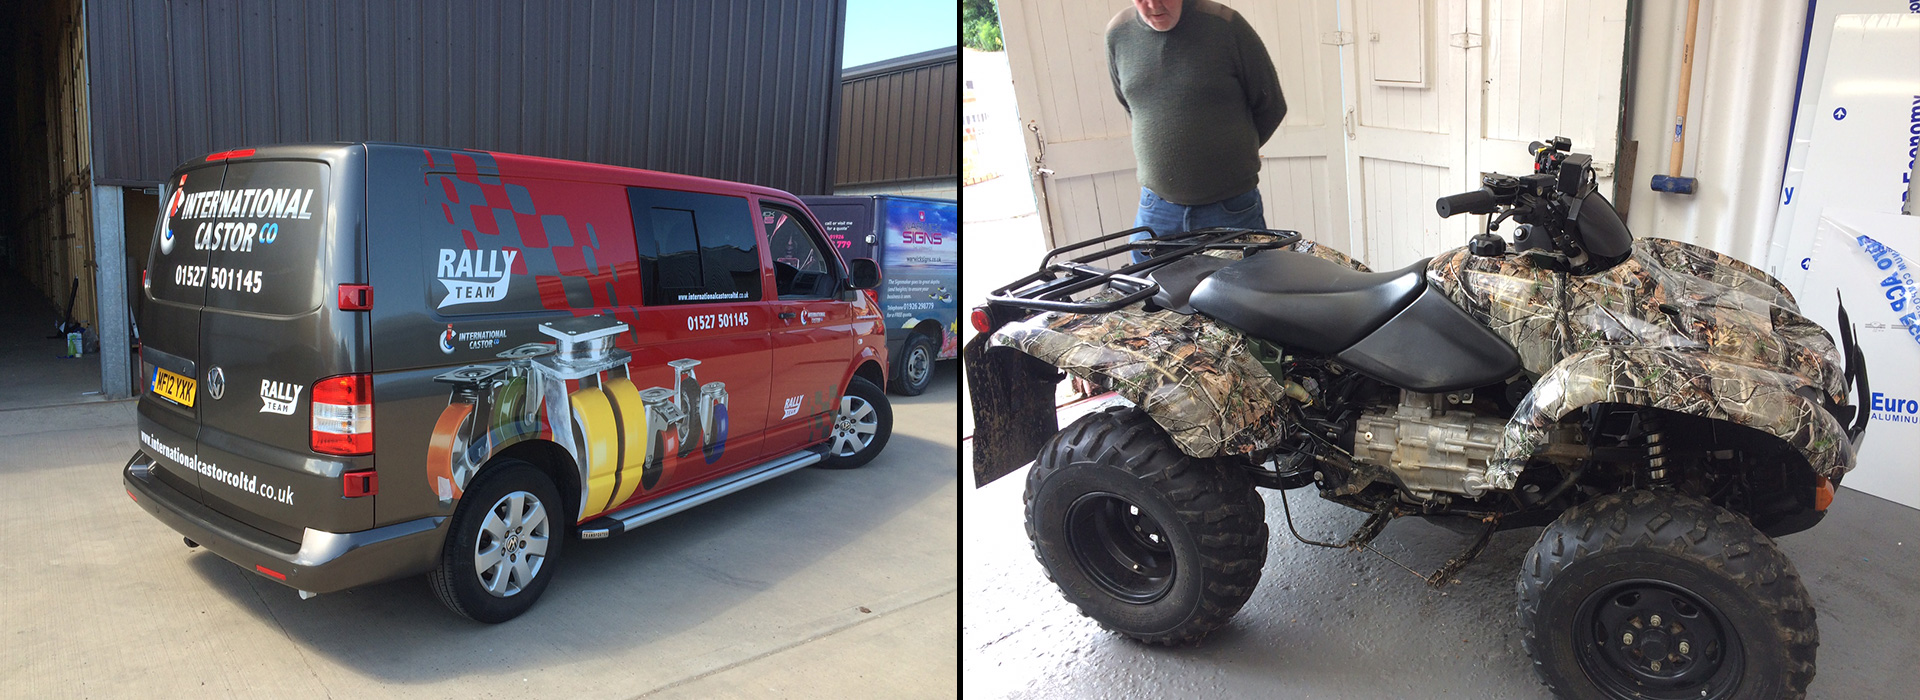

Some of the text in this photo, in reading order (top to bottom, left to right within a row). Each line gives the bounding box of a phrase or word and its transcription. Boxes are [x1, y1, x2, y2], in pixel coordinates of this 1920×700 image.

[181, 188, 314, 219] INTERNATIONAL
[194, 222, 278, 252] CASTOR CO
[837, 240, 852, 249] 779
[902, 231, 943, 245] SIGNS
[437, 249, 517, 278] RALLY
[175, 265, 263, 294] 01527 501145
[455, 286, 495, 299] TEAM
[687, 312, 749, 331] 01527 501145
[459, 330, 507, 341] INTERNATIONAL
[469, 340, 493, 349] CASTOR
[176, 377, 194, 402] YXK
[260, 379, 304, 401] RALLY
[268, 402, 289, 412] TEAM
[1871, 392, 1919, 414] Euro
[140, 430, 295, 505] www.internationalcastorcoltd.co.uk
